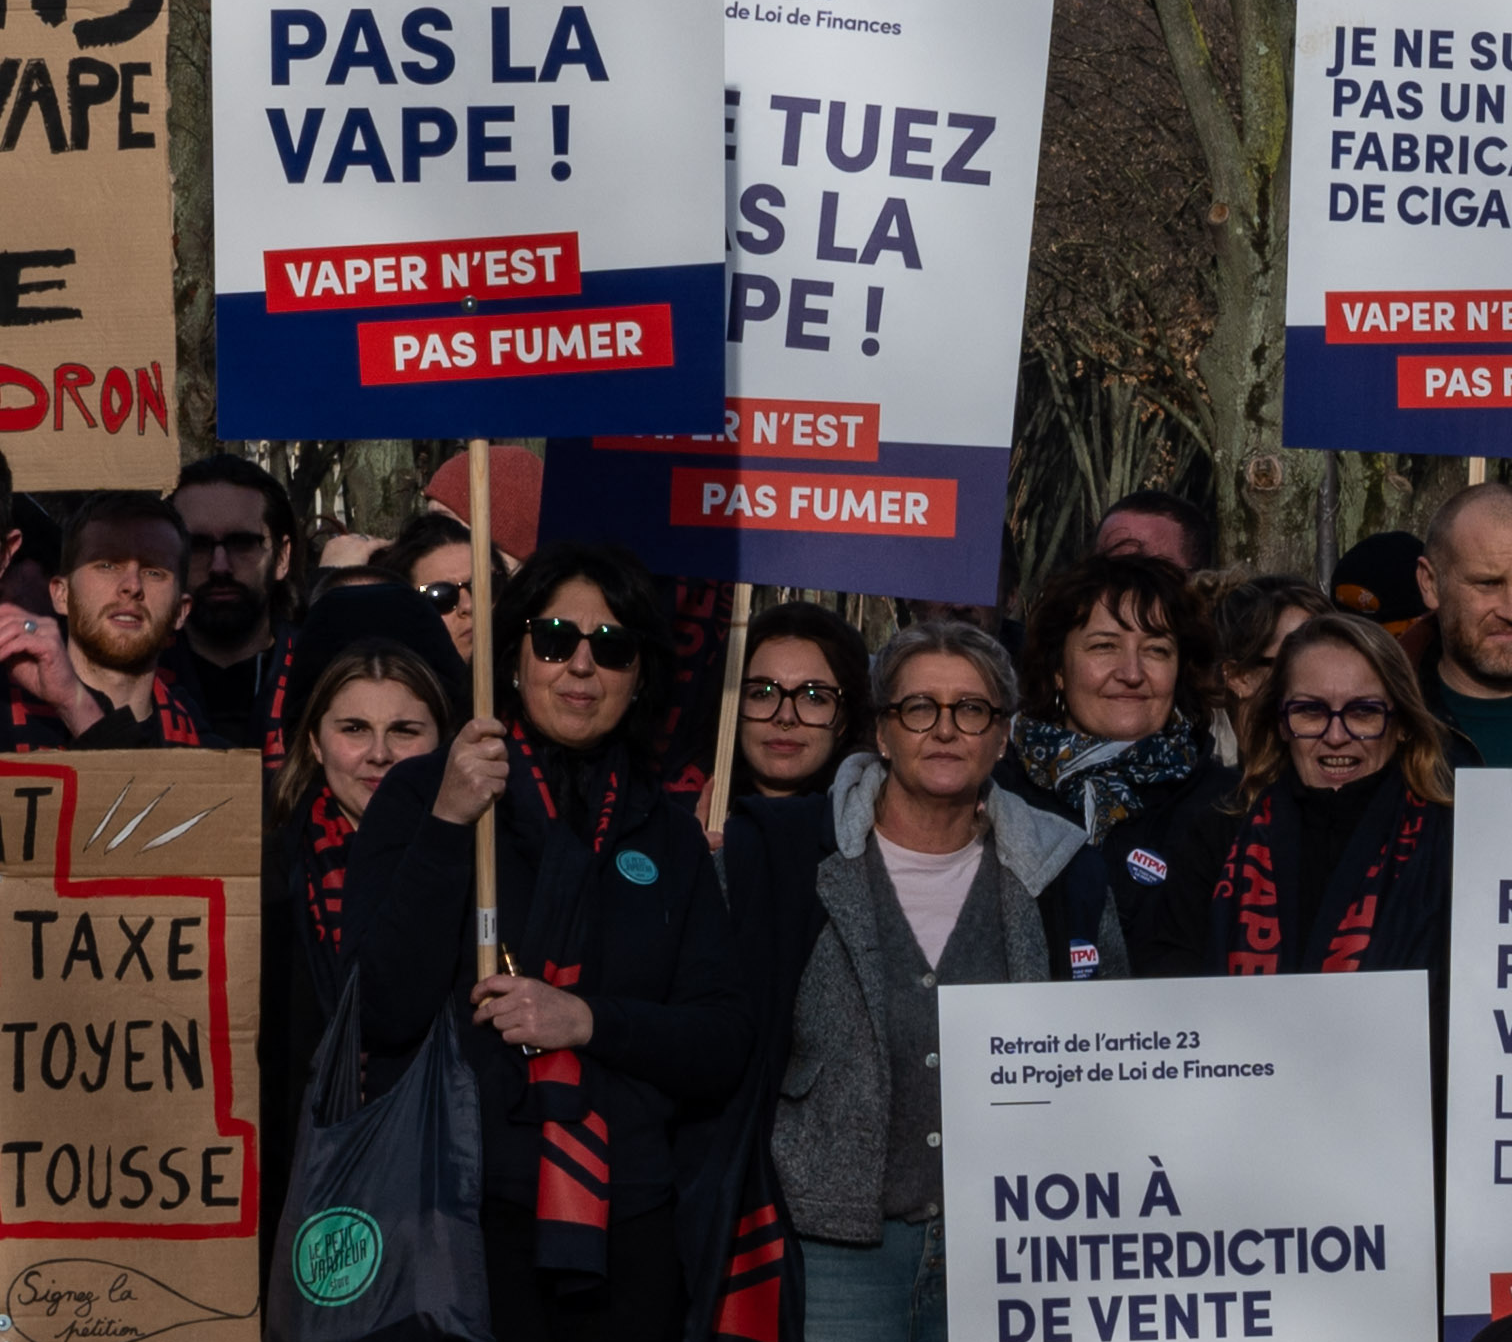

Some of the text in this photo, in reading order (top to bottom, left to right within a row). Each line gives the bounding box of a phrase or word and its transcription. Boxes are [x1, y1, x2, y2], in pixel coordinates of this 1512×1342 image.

[270, 5, 610, 86] PAS LA
[1325, 25, 1377, 78] JE
[1393, 28, 1455, 70] NE
[1332, 78, 1506, 124] PAS UN
[265, 105, 517, 184] VAPE
[1328, 182, 1386, 224] DE
[284, 246, 562, 298] VAPER N'EST
[393, 321, 643, 371] PAS FUMER
[13, 909, 203, 982] TAXE
[990, 1030, 1201, 1055] Retrait de l'article 23
[990, 1059, 1275, 1089] du Projet de Loi de Finances
[1, 1140, 240, 1211] TOUSSE
[994, 1155, 1182, 1223] NON À
[995, 1224, 1386, 1285] L'INTERDICTION
[17, 1270, 138, 1322] Signez la
[1087, 1290, 1273, 1342] VENTE
